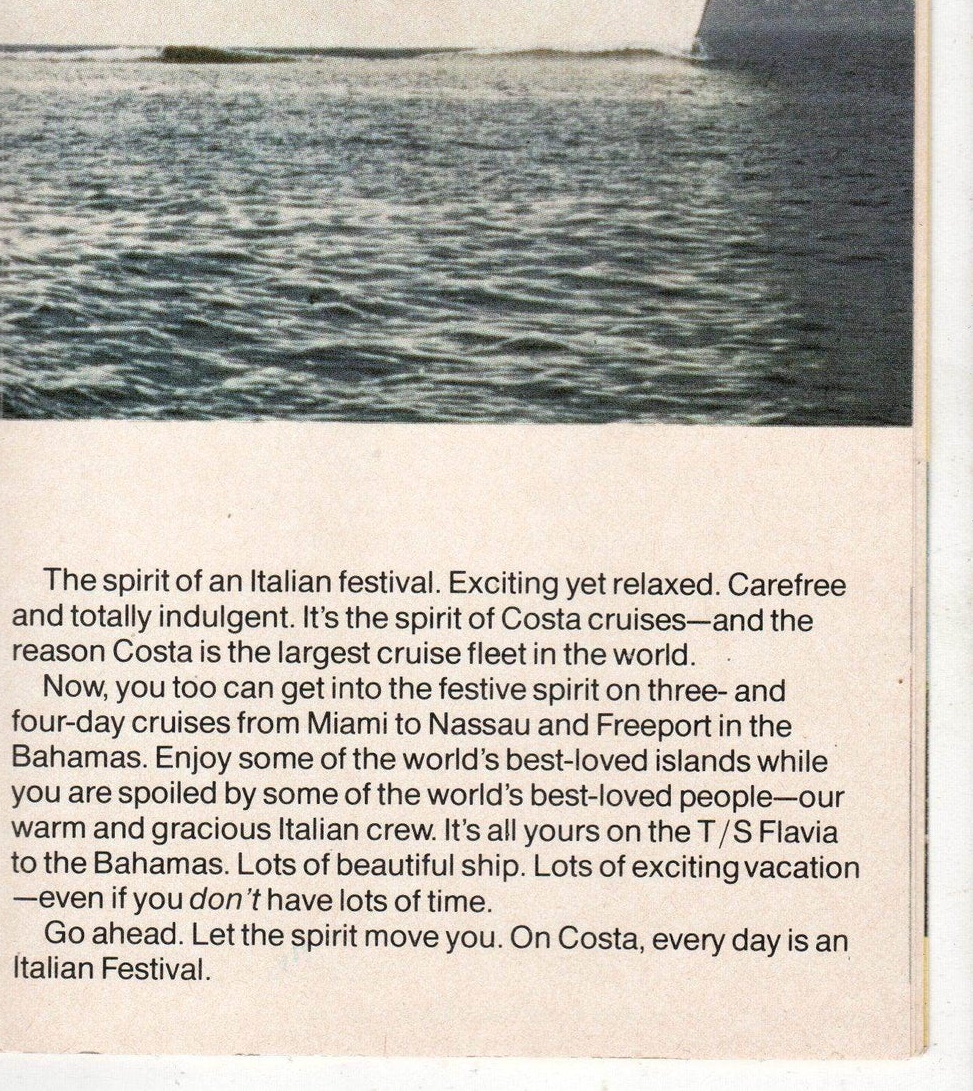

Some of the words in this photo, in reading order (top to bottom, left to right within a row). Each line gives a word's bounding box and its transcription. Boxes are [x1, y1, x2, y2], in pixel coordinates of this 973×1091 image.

[42, 567, 97, 592] The
[102, 568, 170, 598] spirit
[175, 568, 203, 593] of
[209, 573, 243, 593] an
[251, 568, 332, 594] Italian
[338, 569, 441, 594] festival.
[449, 570, 559, 601] Exciting
[565, 572, 607, 601] yet
[613, 571, 720, 597] relaxed.
[728, 571, 847, 597] Carefree
[12, 603, 64, 627] and
[70, 603, 153, 634] totally
[159, 603, 295, 635] indulgent.
[303, 604, 339, 629] It’s
[345, 605, 389, 630] the
[395, 605, 463, 635] spirit
[468, 606, 496, 630] of
[501, 605, 582, 631] Costa
[769, 608, 814, 633] the
[12, 643, 105, 663] reason
[112, 638, 193, 664] Costa
[200, 639, 222, 664] is
[227, 639, 271, 664] the
[278, 640, 371, 671] largest
[377, 640, 462, 665] cruise
[466, 641, 527, 666] fleet
[533, 641, 556, 665] in
[562, 641, 607, 666] the
[612, 642, 696, 667] world.
[43, 673, 108, 702] Now,
[115, 679, 165, 705] you
[172, 675, 217, 699] too
[223, 680, 274, 699] can
[281, 676, 325, 706] get
[331, 675, 382, 700] into
[388, 676, 433, 701] the
[438, 676, 527, 701] festive
[532, 677, 600, 707] spirit
[605, 682, 640, 702] on
[647, 677, 728, 702] three-
[734, 678, 786, 703] and
[11, 708, 126, 740] four-day
[131, 710, 231, 734] cruises
[236, 710, 300, 735] from
[308, 710, 388, 735] Miami
[394, 712, 422, 736] to
[429, 711, 530, 736] Nassau
[537, 712, 589, 737] and
[597, 712, 712, 743] Freeport
[719, 713, 742, 737] in
[748, 713, 792, 738] the
[12, 743, 148, 769] Bahamas.
[156, 745, 232, 776] Enjoy
[238, 751, 314, 770] some
[320, 746, 347, 770] of
[352, 746, 397, 771] the
[402, 747, 500, 771] world’s
[506, 747, 648, 772] best-loved
[656, 748, 751, 773] islands
[756, 749, 828, 773] while
[11, 784, 61, 809] you
[68, 785, 112, 804] are
[118, 780, 217, 810] spoiled
[225, 780, 257, 811] by
[263, 786, 339, 806] some
[344, 781, 372, 806] of
[376, 781, 421, 806] the
[426, 782, 524, 807] world’s
[531, 782, 672, 808] best-loved
[10, 820, 86, 839] warm
[93, 815, 145, 840] and
[151, 816, 272, 846] gracious
[279, 816, 359, 841] Italian
[366, 822, 437, 842] crew.
[445, 817, 481, 842] It’s
[487, 818, 516, 842] all
[523, 823, 601, 848] yours
[606, 824, 641, 843] on
[647, 819, 691, 844] the
[759, 819, 839, 844] Flavia
[10, 851, 37, 874] to
[43, 850, 87, 875] the
[94, 850, 229, 876] Bahamas.
[238, 851, 297, 876] Lots
[303, 852, 331, 876] of
[337, 852, 454, 877] beautiful
[461, 853, 526, 883] ship.
[534, 853, 593, 878] Lots
[599, 854, 626, 878] of
[631, 854, 739, 885] exciting
[743, 855, 860, 880] vacation
[111, 885, 128, 909] if
[132, 891, 184, 916] you
[188, 886, 263, 912] don’t
[267, 887, 333, 912] have
[340, 888, 388, 913] lots
[394, 888, 422, 913] of
[427, 889, 492, 914] time.
[44, 919, 85, 945] Go
[91, 920, 184, 946] ahead.
[192, 921, 236, 946] Let
[240, 922, 285, 947] the
[291, 923, 358, 953] spirit
[365, 929, 439, 948] move
[445, 929, 503, 955] you.
[510, 924, 551, 949] On
[558, 925, 645, 954] Costa,
[652, 932, 726, 958] every
[731, 927, 782, 958] day
[788, 927, 809, 953] is
[815, 933, 848, 953] an
[14, 955, 94, 980] Italian
[102, 956, 211, 981] Festival.
